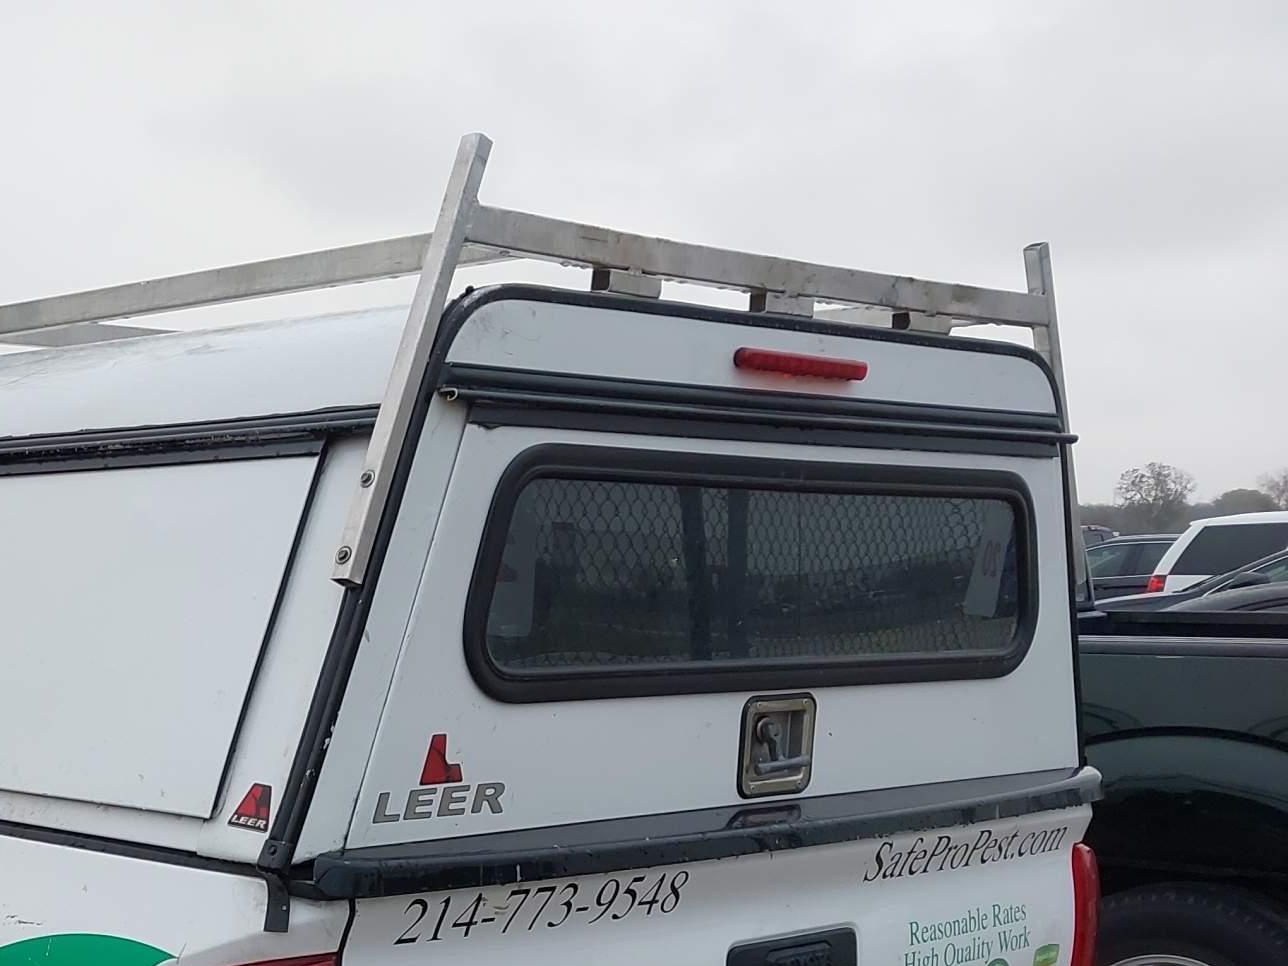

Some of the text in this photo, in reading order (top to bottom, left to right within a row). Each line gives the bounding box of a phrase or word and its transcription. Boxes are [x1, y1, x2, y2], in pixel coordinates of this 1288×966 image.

[230, 814, 268, 829] LEER
[372, 782, 505, 824] LEER
[862, 825, 1068, 883] SafeProPest.com
[393, 869, 690, 946] 214-773-9548
[908, 903, 1027, 946] Reasonable Rates
[997, 926, 1031, 951] Work
